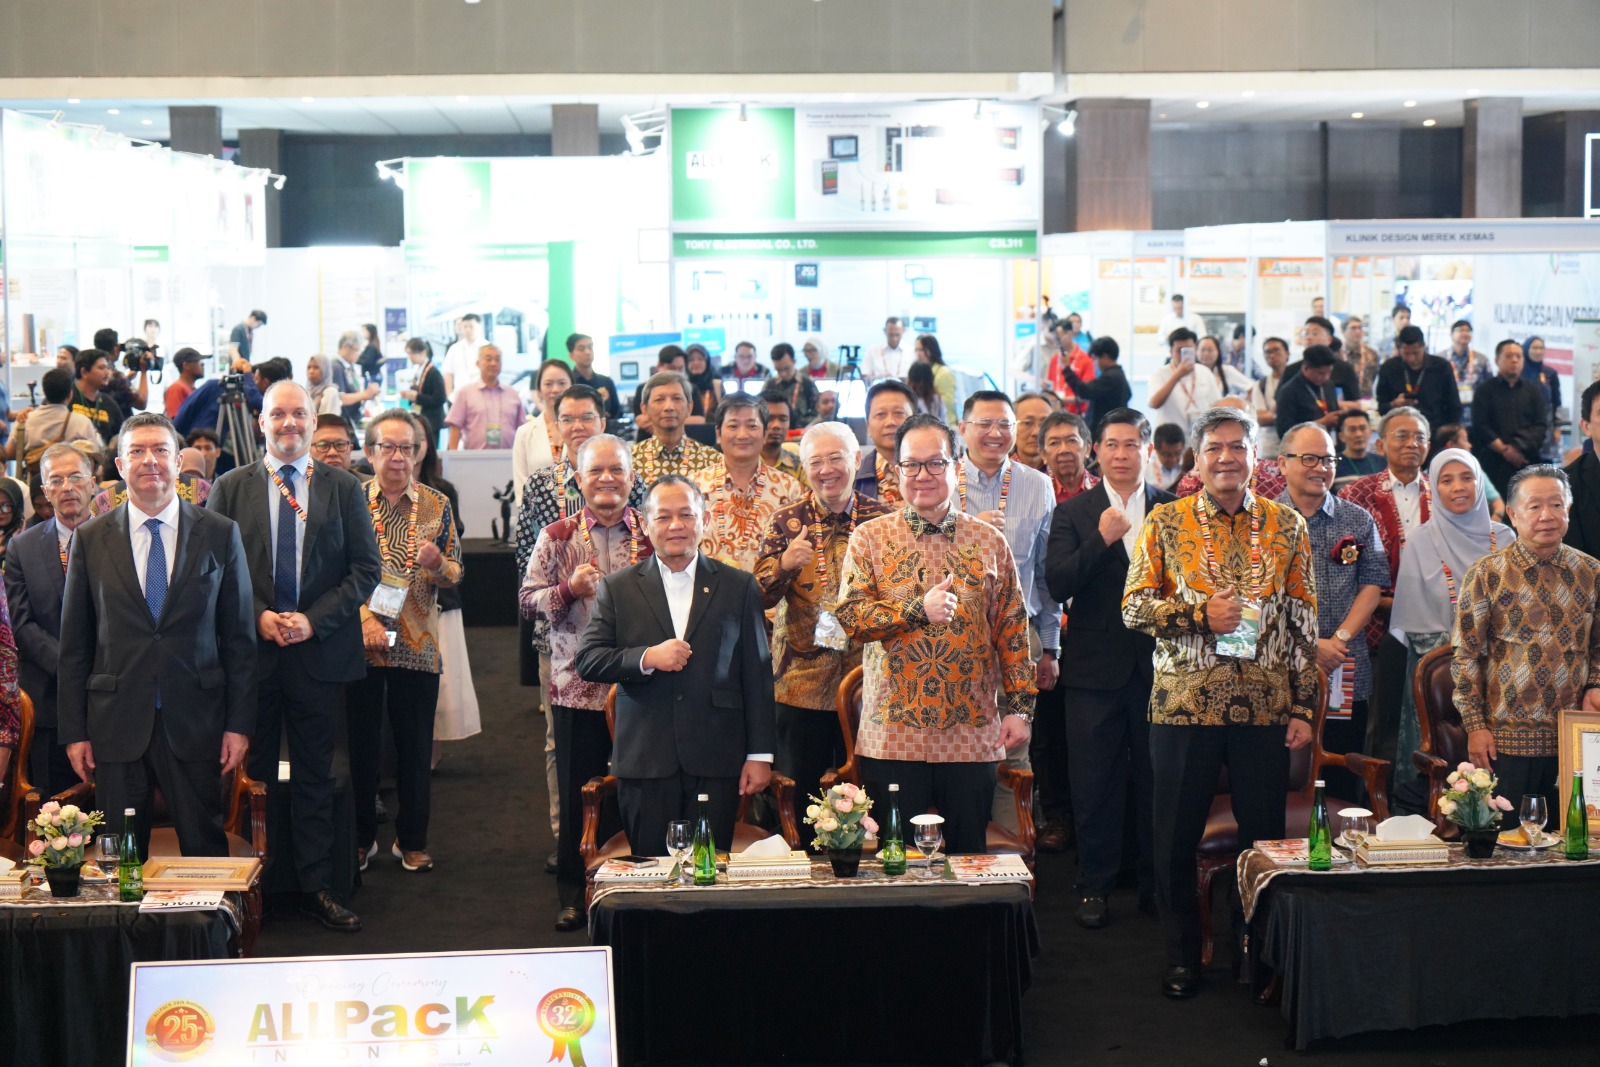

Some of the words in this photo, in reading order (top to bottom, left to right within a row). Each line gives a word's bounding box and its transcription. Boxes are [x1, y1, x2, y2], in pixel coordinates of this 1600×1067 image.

[1345, 234, 1378, 243] KLINIK
[1381, 233, 1418, 242] DESIGN
[1421, 233, 1456, 242] MEREK
[1459, 233, 1495, 242] KEMAS
[684, 240, 711, 250] TOKY
[1271, 262, 1301, 273] Asia
